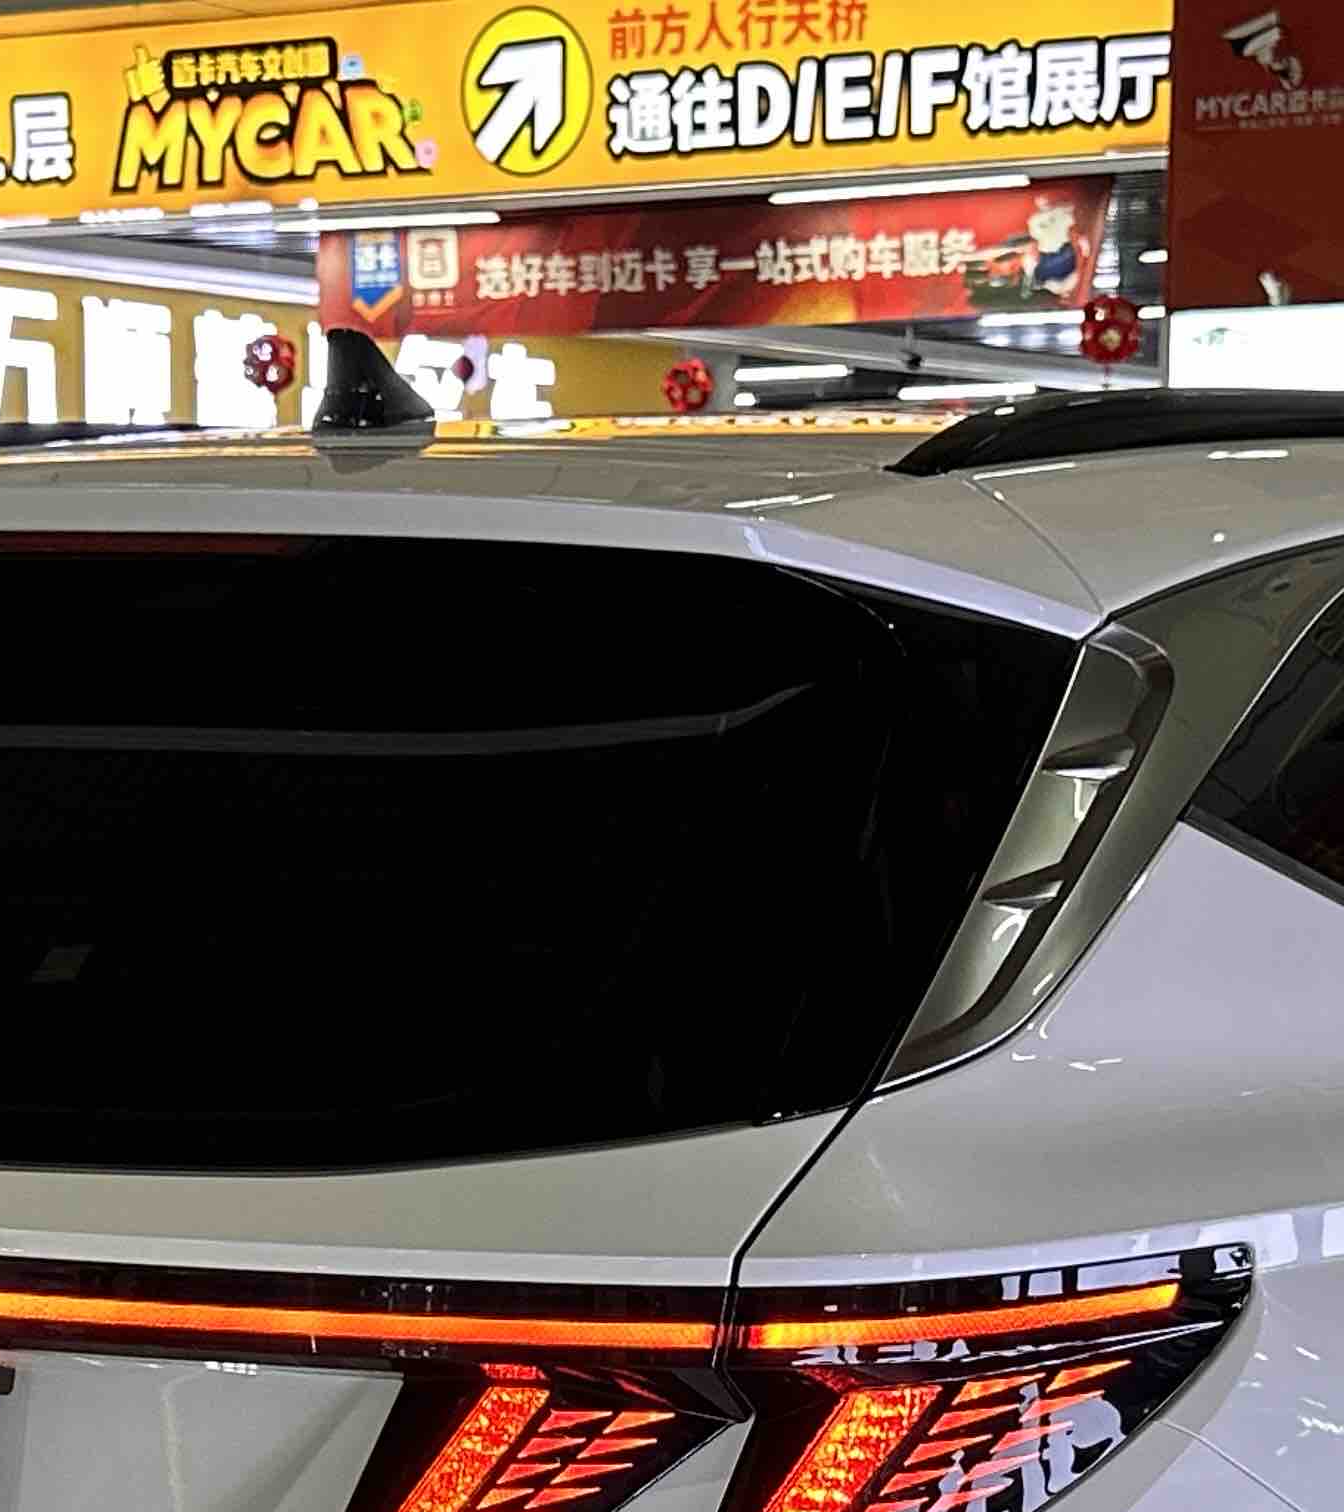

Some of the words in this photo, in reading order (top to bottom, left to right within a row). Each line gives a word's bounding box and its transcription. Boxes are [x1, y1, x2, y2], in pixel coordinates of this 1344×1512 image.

[609, 0, 868, 60] 前方人行天桥
[113, 84, 424, 192] MYCAR
[608, 35, 1171, 156] 通往D/E/F馆展厅
